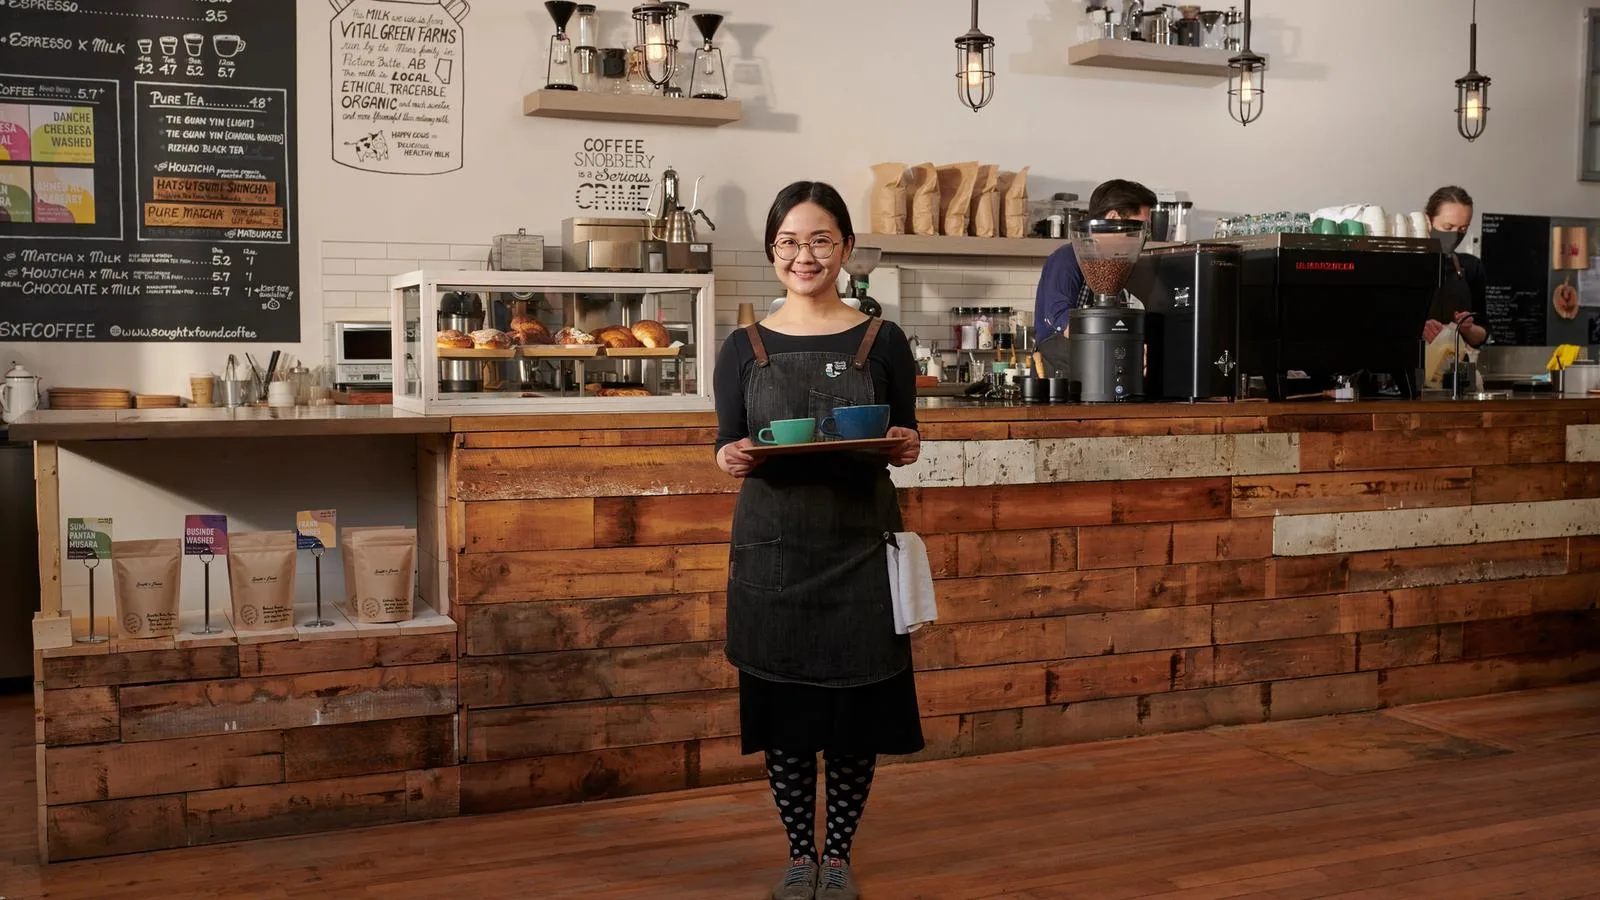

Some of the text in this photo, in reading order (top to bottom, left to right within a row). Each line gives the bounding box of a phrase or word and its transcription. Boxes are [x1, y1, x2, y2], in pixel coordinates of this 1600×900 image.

[205, 9, 228, 22] 3.5
[366, 9, 390, 20] MILK
[340, 21, 456, 44] VITAL GREEN FARMS
[9, 32, 72, 49] ESPRESSO
[92, 38, 125, 54] MILK
[364, 41, 373, 54] by
[378, 43, 389, 52] the
[342, 53, 375, 66] Picture
[408, 58, 426, 70] AB
[217, 67, 236, 78] 5.7
[390, 83, 446, 97] TRACEABLE
[150, 91, 181, 105] PURE
[184, 92, 204, 106] TEA
[53, 111, 91, 123] DANCHE
[166, 115, 181, 124] TIE
[184, 115, 206, 125] GUAN
[209, 117, 224, 126] YIN
[43, 123, 92, 135] CHELBESA
[166, 129, 181, 138] TIE
[183, 131, 206, 139] GUAN
[209, 131, 223, 140] YIN
[391, 131, 411, 139] HAPPY
[51, 137, 92, 148] WASHED
[584, 138, 645, 154] COFFEE
[168, 144, 244, 155] RIZHAO BLACK TEA
[434, 150, 450, 158] MILK
[574, 152, 655, 168] SNOBBERY
[168, 162, 215, 173] HOUJICHA
[595, 168, 653, 182] Serious
[157, 180, 268, 194] HATSUTSUMI SHINCHA
[575, 183, 650, 211] CRIME
[148, 206, 179, 217] PURE
[183, 207, 223, 219] MATCHA
[237, 229, 283, 239] MATSUKAZE
[21, 249, 73, 262] MATCHA
[90, 251, 121, 263] MILK
[212, 255, 231, 266] 5.2
[21, 267, 84, 278] HOUJICHA
[101, 268, 129, 280] MILK
[212, 272, 231, 282] 5.7
[22, 281, 97, 295] CHOCOLATE
[111, 284, 140, 295] MILK
[212, 286, 231, 297] 5.7
[69, 531, 96, 540] PANTAN
[186, 527, 214, 536] BUSINDE
[69, 540, 98, 549] MUSARA
[186, 536, 214, 545] WASHED
